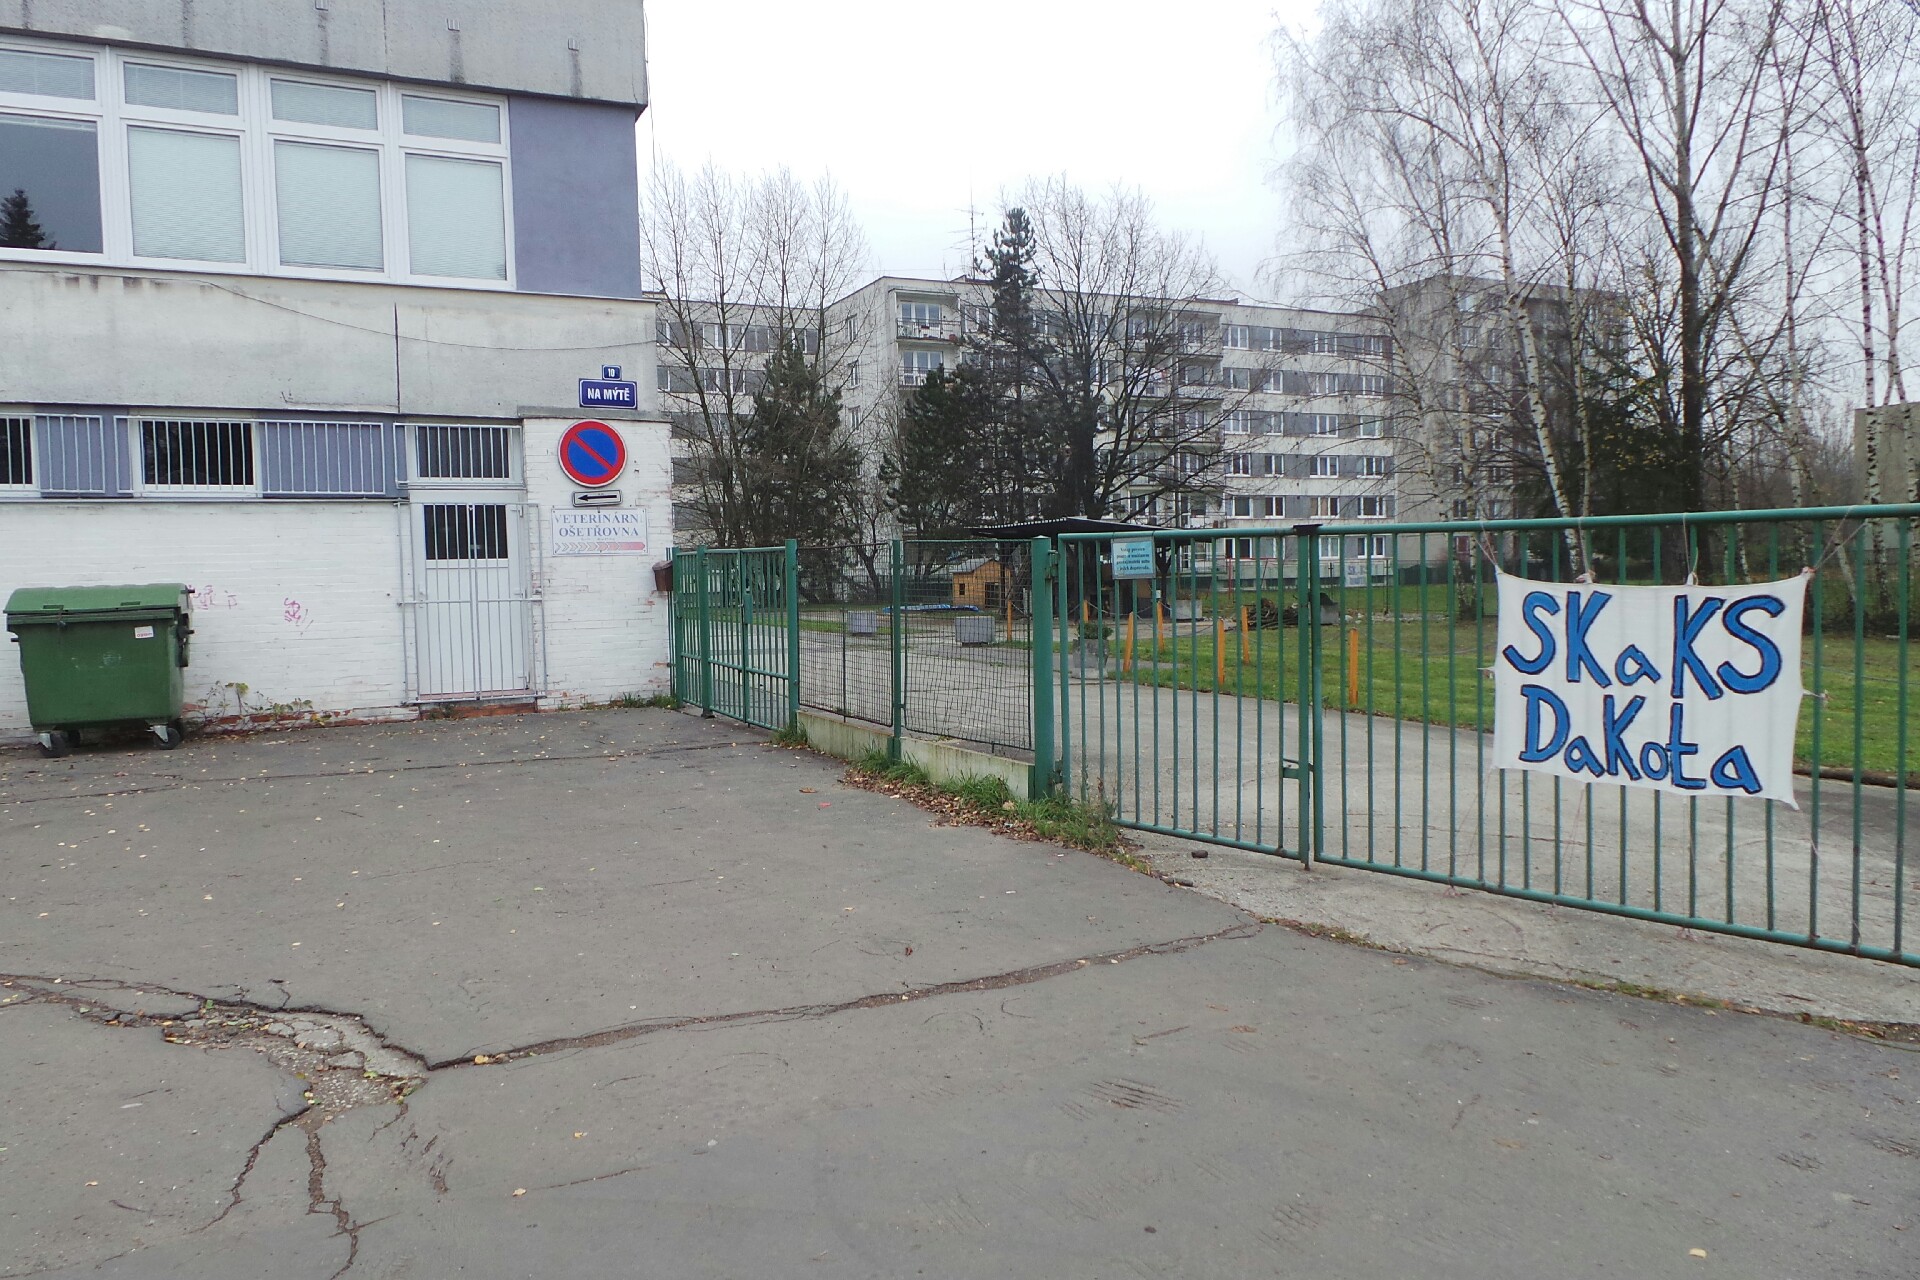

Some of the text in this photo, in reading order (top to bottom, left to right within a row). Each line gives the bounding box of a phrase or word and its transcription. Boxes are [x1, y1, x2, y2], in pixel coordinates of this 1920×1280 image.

[608, 368, 616, 378] 10
[587, 386, 630, 401] NA MÝTĚ
[559, 525, 639, 537] OŠETŘOVNA
